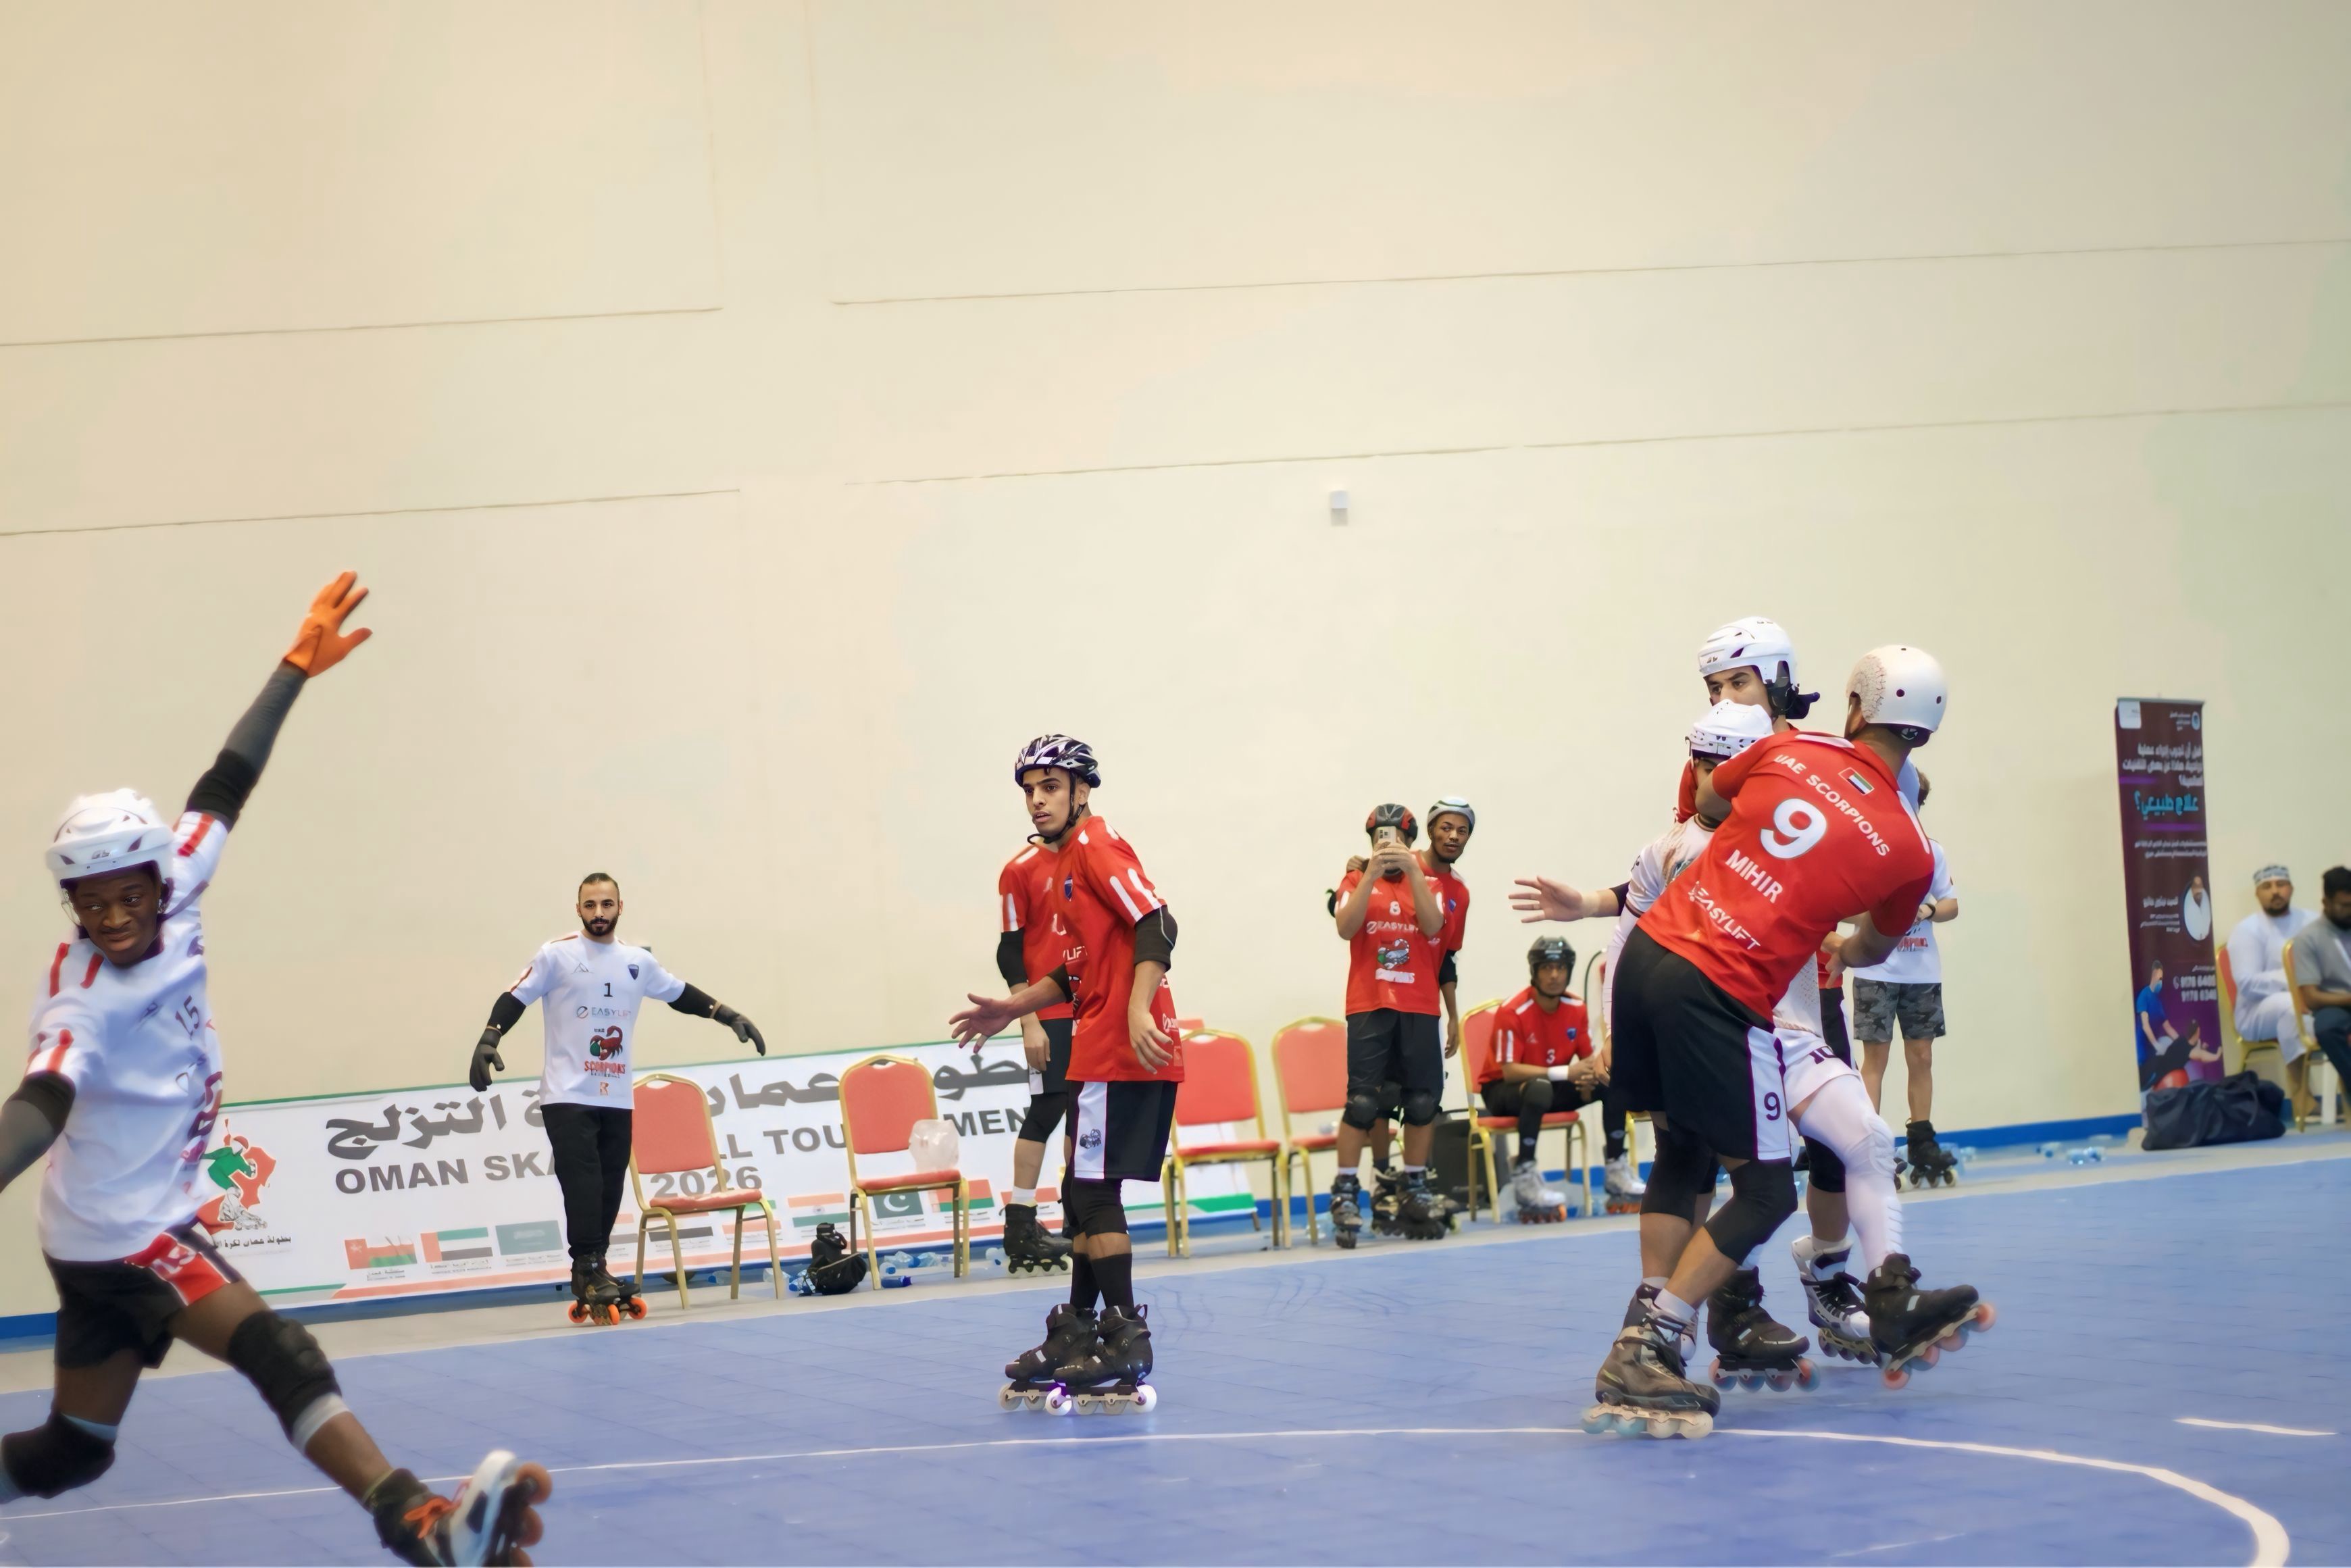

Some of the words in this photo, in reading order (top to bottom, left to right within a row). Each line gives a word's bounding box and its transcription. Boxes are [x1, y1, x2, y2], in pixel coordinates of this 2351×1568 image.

[1773, 755, 1806, 774] UAE
[1806, 774, 1890, 856] SCORPIONS
[1760, 798, 1827, 859] 9
[1725, 849, 1784, 903] MIHIR
[604, 982, 613, 997] 1
[175, 995, 200, 1040] 15
[1546, 1048, 1556, 1064] 3
[326, 1094, 507, 1160] التزلج
[1764, 1092, 1781, 1121] 9
[335, 1159, 469, 1194] OMAN
